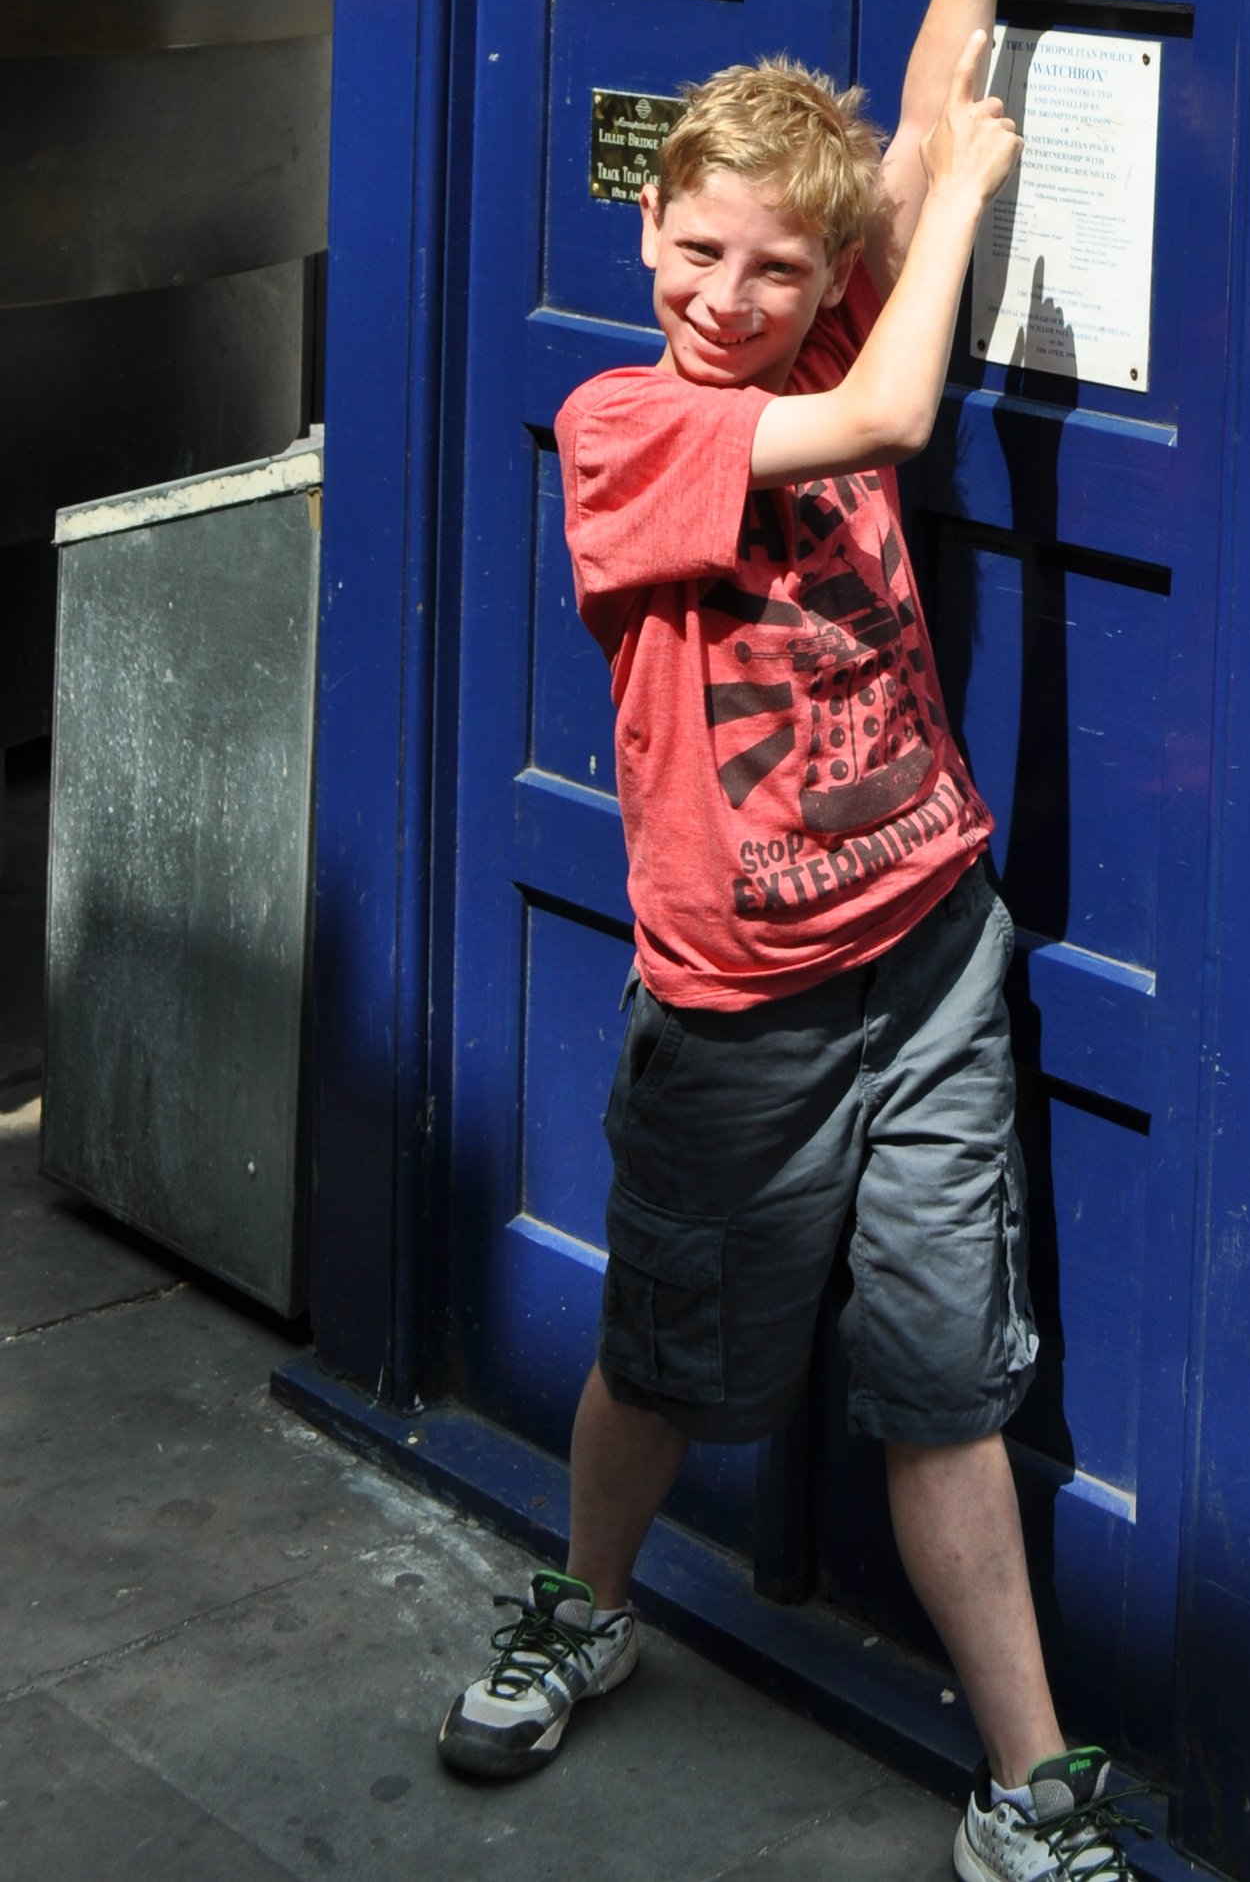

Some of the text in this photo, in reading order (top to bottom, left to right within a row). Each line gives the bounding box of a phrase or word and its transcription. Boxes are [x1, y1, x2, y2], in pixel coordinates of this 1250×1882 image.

[1025, 41, 1097, 59] METROPOLITAN
[1099, 49, 1135, 63] POLICE
[1058, 85, 1113, 99] CONSTRUCTED
[1049, 98, 1089, 111] INSTALLED
[1031, 134, 1088, 150] METROPOLITAN
[1034, 148, 1084, 163] PARTNERSHIP
